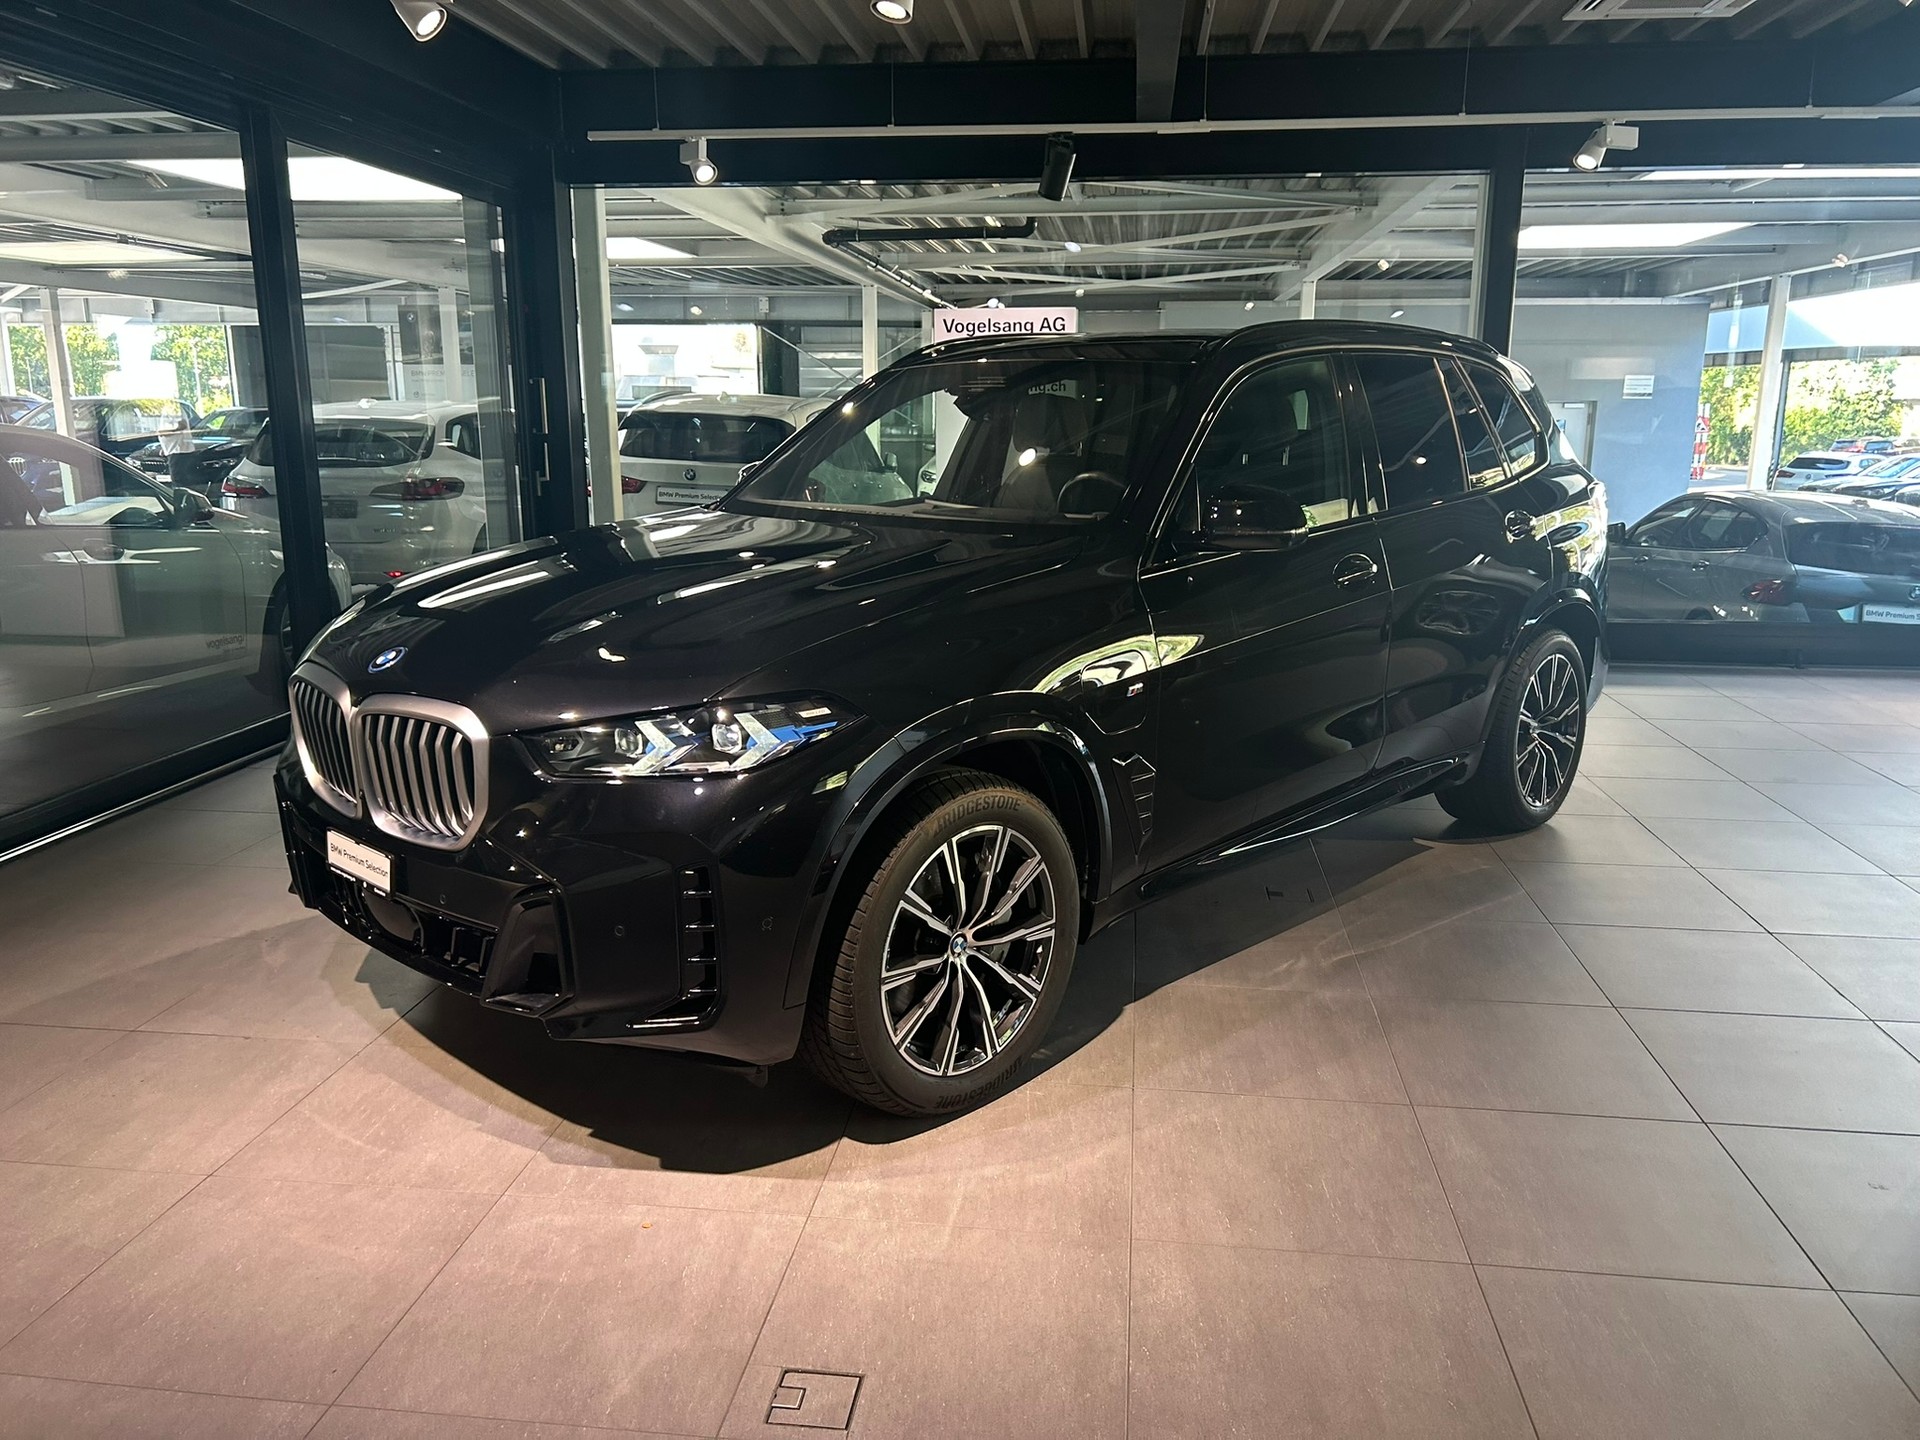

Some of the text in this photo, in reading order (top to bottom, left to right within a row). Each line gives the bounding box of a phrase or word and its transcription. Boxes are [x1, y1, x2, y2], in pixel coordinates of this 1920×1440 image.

[942, 316, 1066, 337] Vogelsang AG
[1885, 611, 1915, 620] Premium
[933, 795, 1020, 838] BRIDGESTONE
[331, 842, 343, 856] BMW
[343, 849, 365, 867] Premium
[365, 859, 389, 879] Selection
